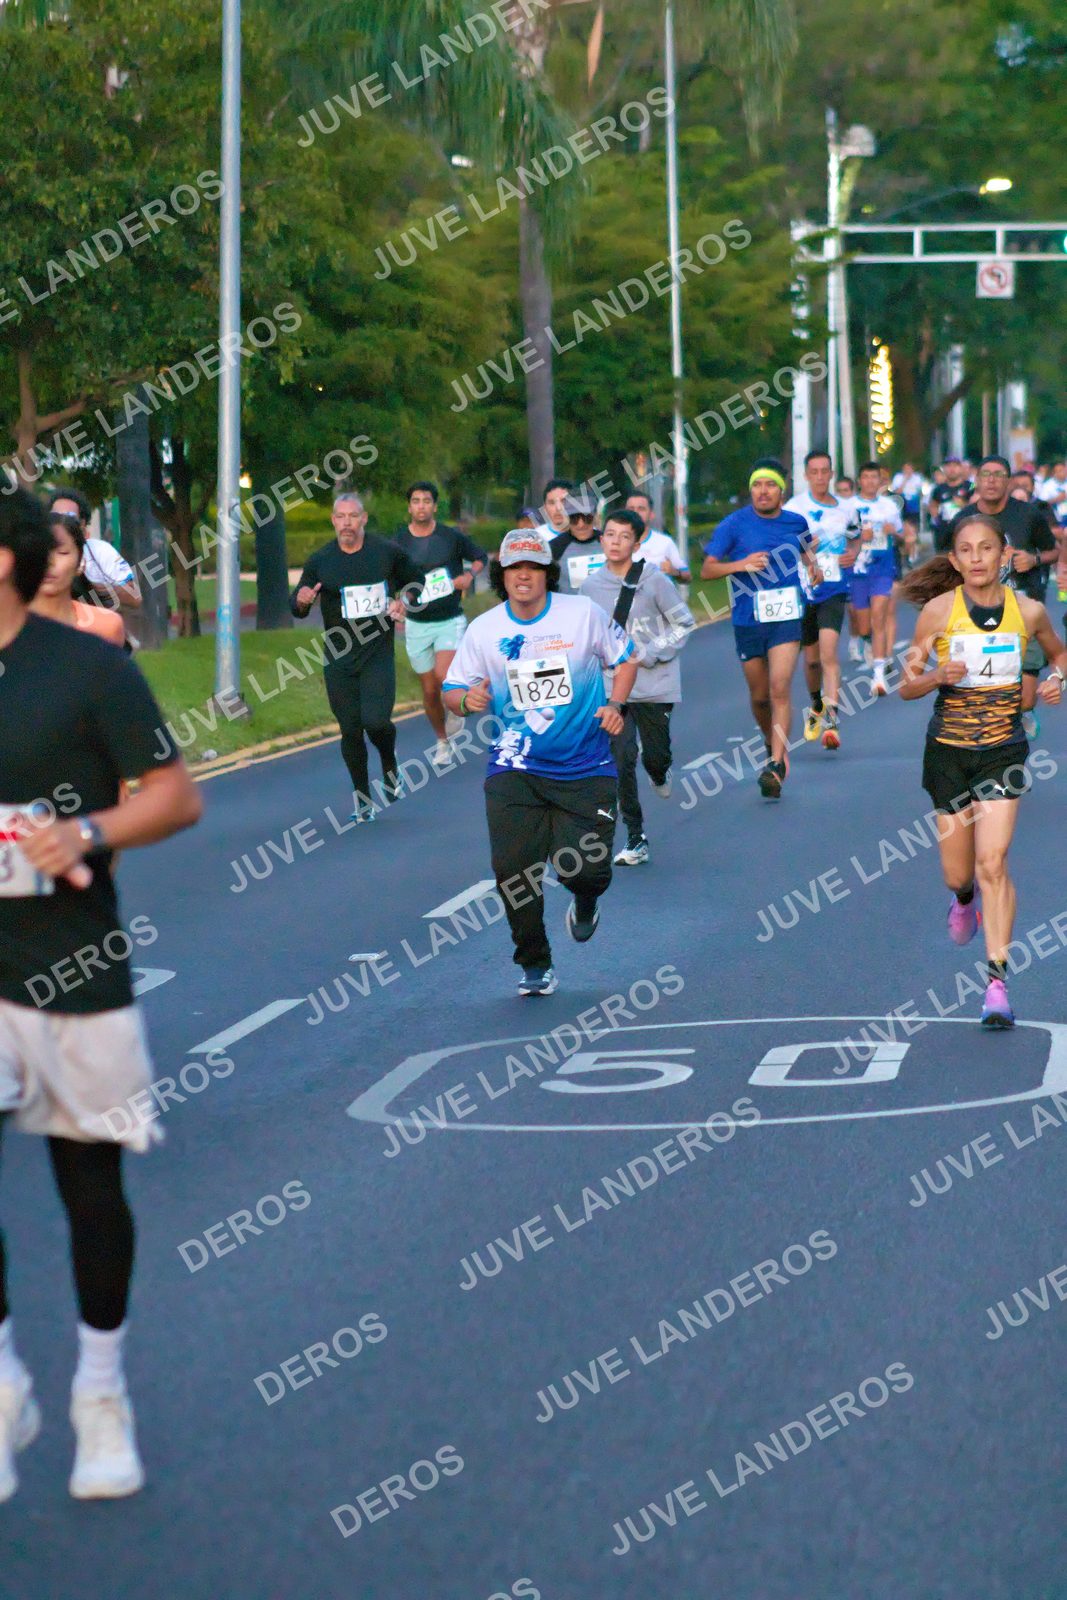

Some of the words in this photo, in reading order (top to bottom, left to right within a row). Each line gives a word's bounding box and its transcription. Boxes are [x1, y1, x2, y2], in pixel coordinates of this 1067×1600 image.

[425, 581, 449, 597] 152
[353, 597, 381, 613] 124
[765, 601, 794, 617] 875
[979, 657, 995, 678] 4
[513, 676, 571, 704] 1826
[539, 1042, 911, 1094] 50
